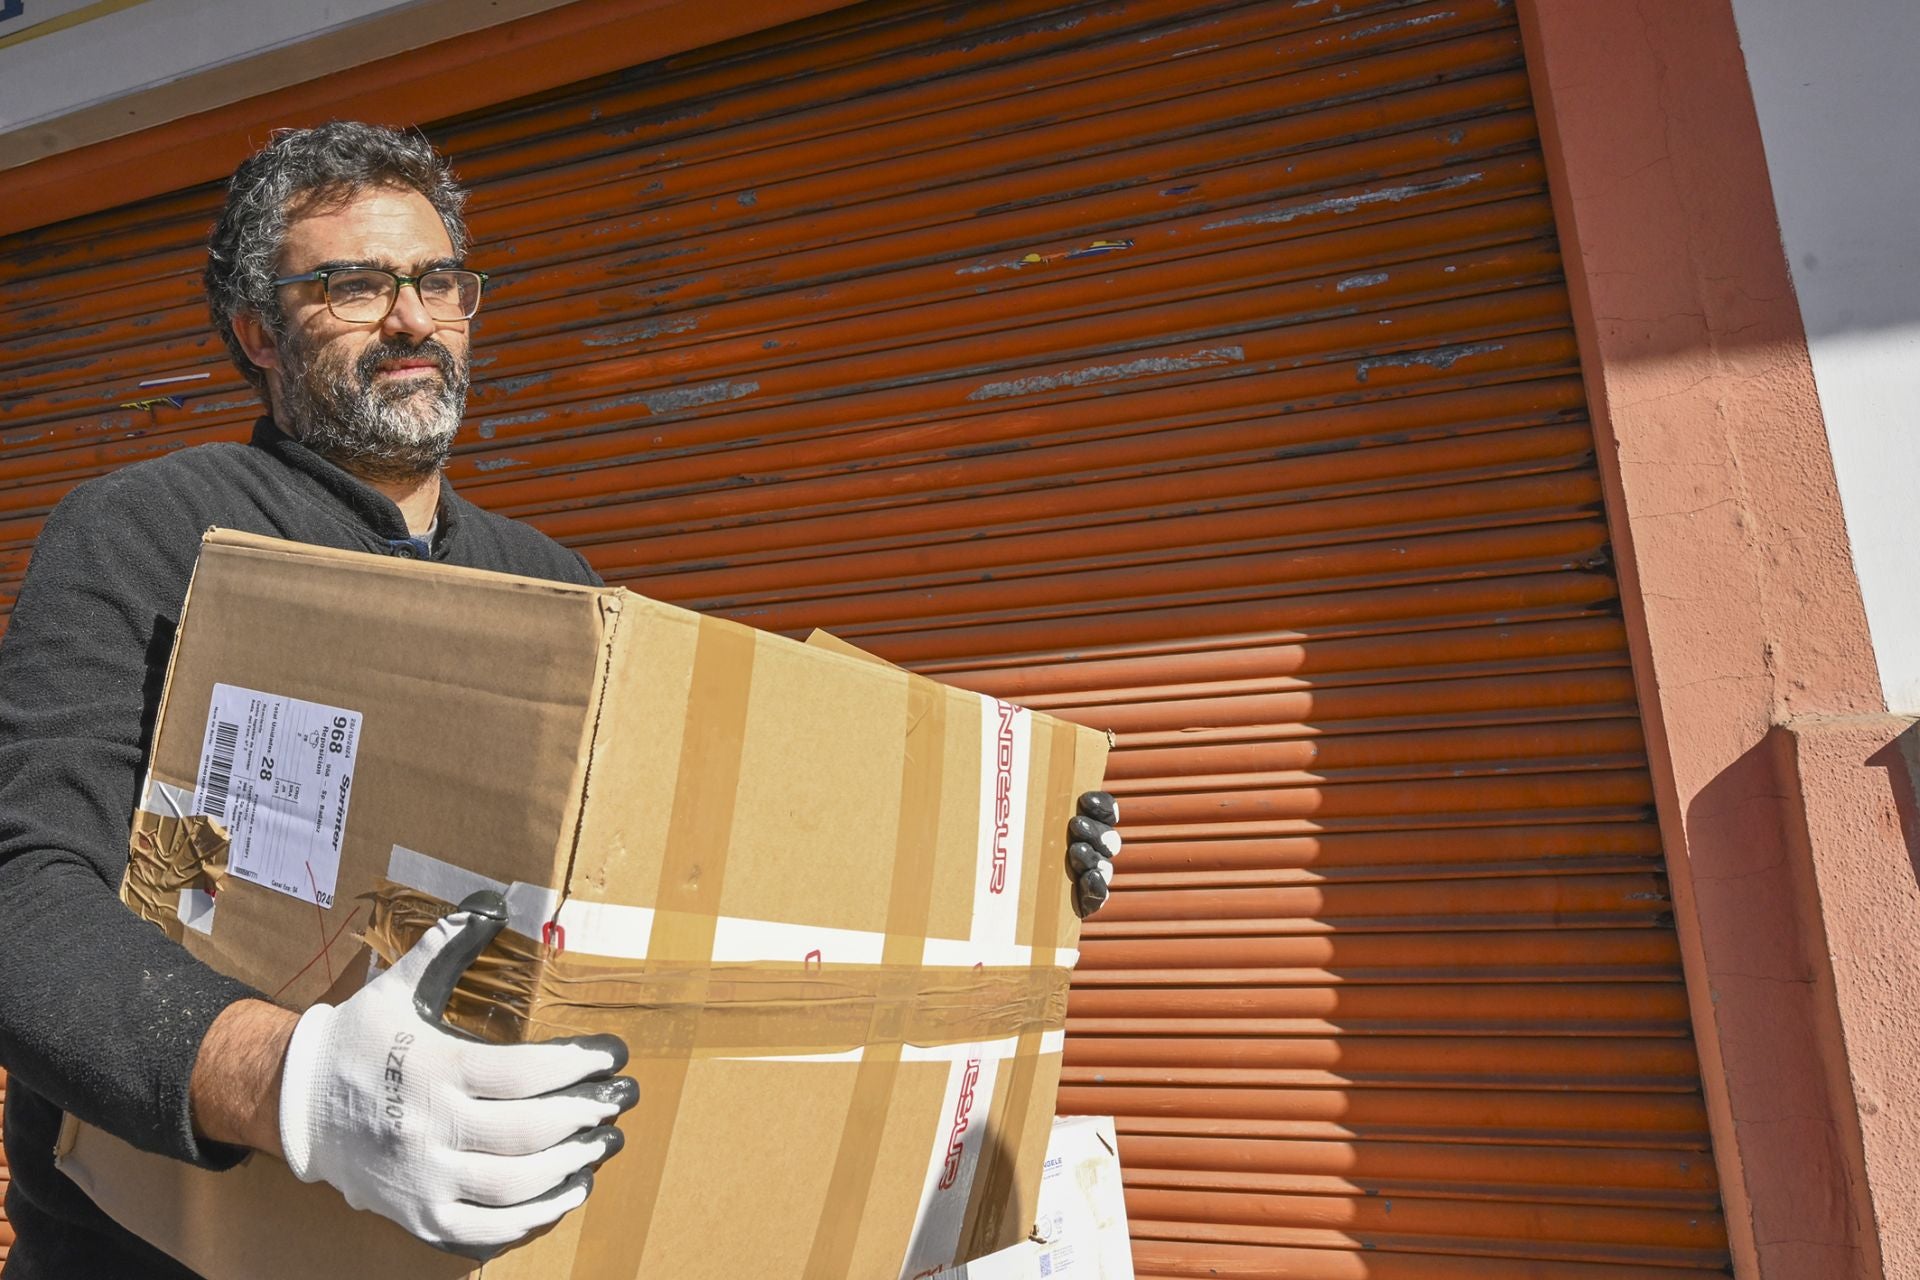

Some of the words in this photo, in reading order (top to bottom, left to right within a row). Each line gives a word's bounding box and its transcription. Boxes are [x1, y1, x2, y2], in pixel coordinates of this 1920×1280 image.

[272, 703, 280, 720] Total
[316, 726, 329, 775] Reposicion
[329, 716, 347, 754] 968
[259, 756, 274, 781] 28
[315, 804, 325, 833] Badajoz
[332, 774, 350, 852] Sprinter
